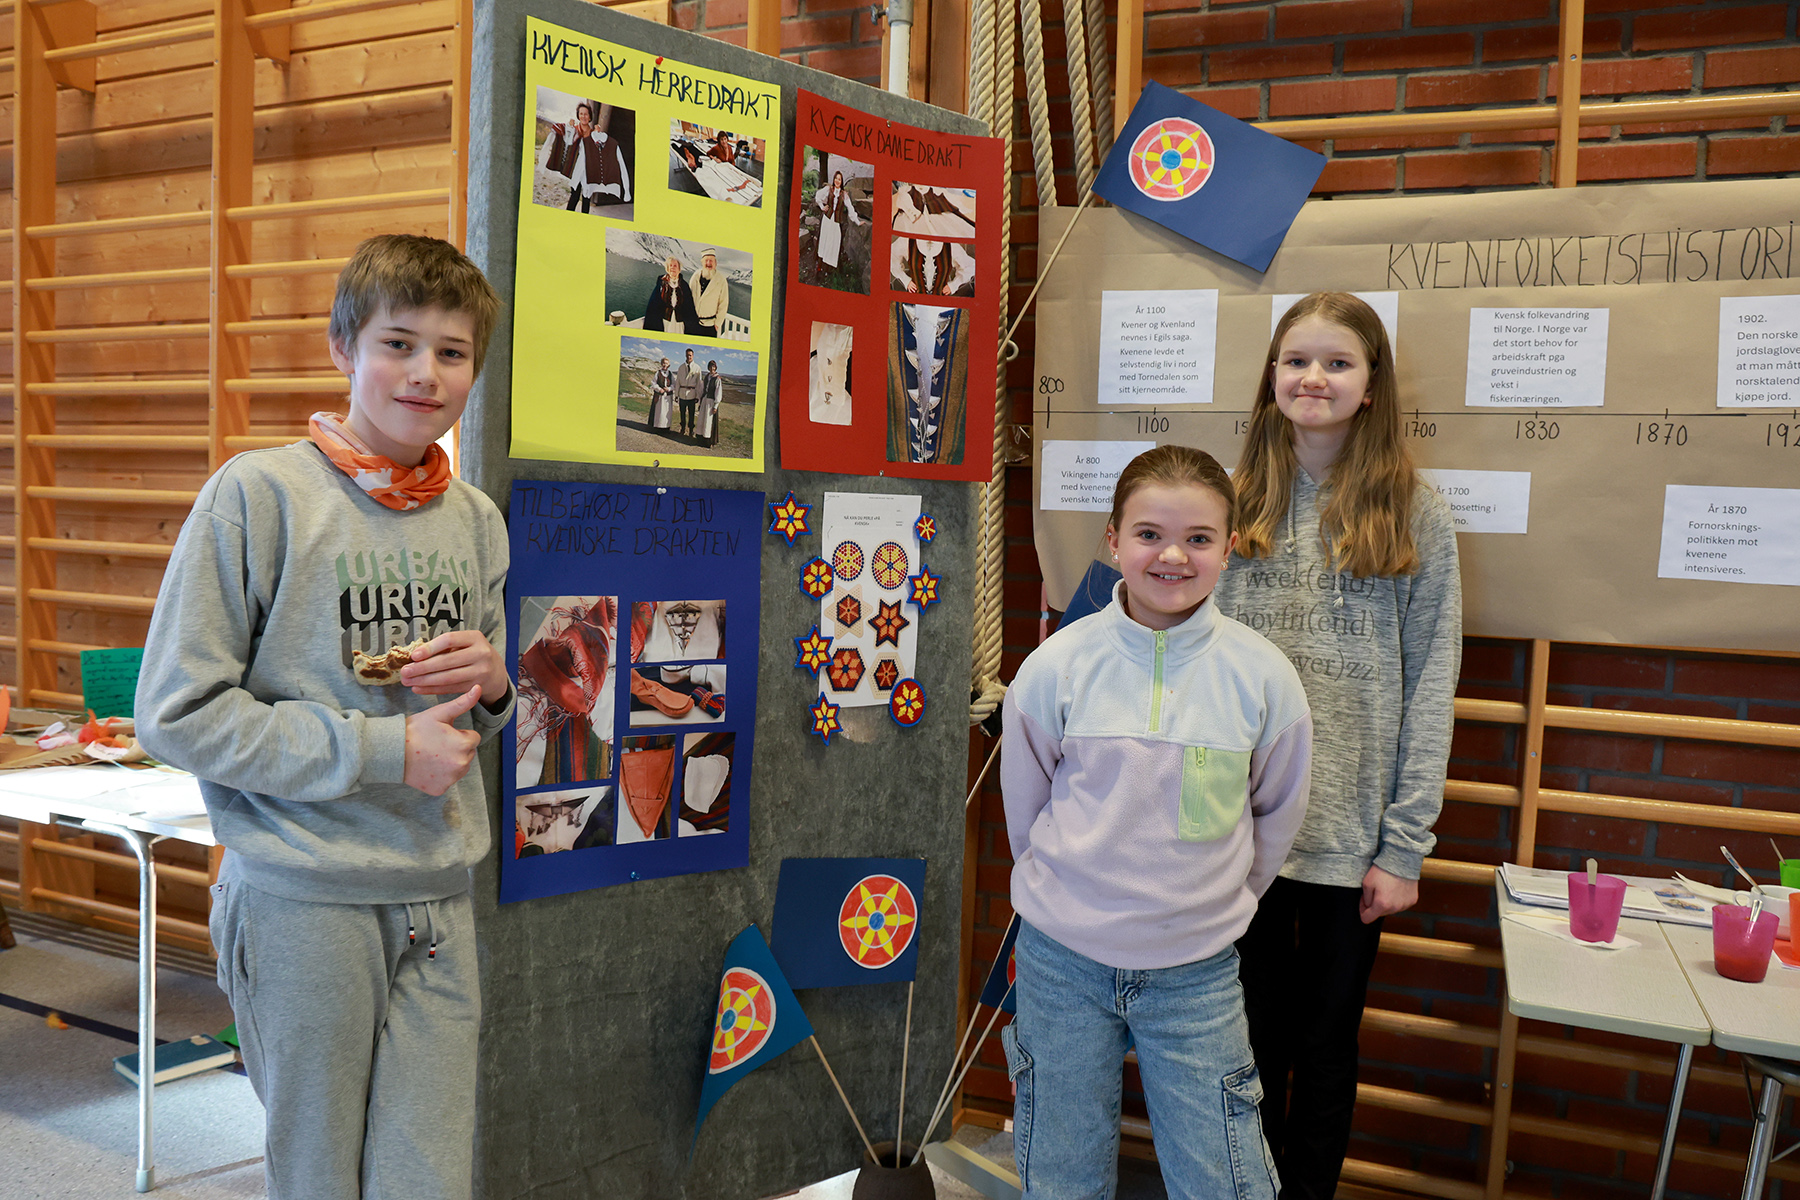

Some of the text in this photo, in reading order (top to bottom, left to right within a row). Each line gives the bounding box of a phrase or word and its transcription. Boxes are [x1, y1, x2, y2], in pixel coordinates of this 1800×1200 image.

[533, 30, 778, 121] KVENSK HERREDRAKT
[810, 105, 873, 151] KVENSK
[1135, 305, 1166, 314] År 1100
[1494, 310, 1590, 320] Kvensk folkevandring
[1738, 314, 1768, 324] 1902.
[1121, 321, 1147, 329] Kvener
[1160, 320, 1196, 328] Kvenland
[1493, 325, 1503, 333] til
[1504, 326, 1535, 335] Norge.
[1542, 325, 1571, 335] Norge
[1737, 330, 1799, 340] Den norske
[1153, 333, 1171, 342] Egils
[1493, 339, 1508, 347] det
[1534, 339, 1562, 347] behov
[1564, 339, 1578, 347] for
[1120, 348, 1152, 356] Kvenene
[1492, 353, 1565, 362] arbeidskraft pga
[1119, 361, 1162, 369] selvstendig
[1163, 360, 1173, 368] liv
[1178, 360, 1197, 368] nord
[1736, 362, 1747, 371] at
[1749, 362, 1774, 370] man
[1491, 367, 1577, 376] gruveindustrien og
[1119, 373, 1136, 381] med
[1138, 373, 1181, 381] Tornedalen
[1038, 375, 1065, 395] 800
[1490, 381, 1514, 389] vekst
[1118, 386, 1188, 395] sitt kjerneområde.
[1490, 394, 1562, 404] fiskerinæringen.
[1735, 392, 1792, 403] kjøpe jord.
[1137, 416, 1170, 434] 1100
[1404, 421, 1437, 439] 1700
[1515, 420, 1561, 441] 1830
[1636, 422, 1689, 447] 1870
[1075, 455, 1085, 464] År
[1061, 471, 1098, 480] Vikingene
[1061, 483, 1078, 491] med
[1080, 483, 1112, 491] kvenene
[1436, 485, 1470, 496] År 1700
[1060, 496, 1090, 504] svenske
[516, 487, 631, 522] TILBEHØR
[672, 496, 714, 524] DEN
[1707, 503, 1747, 515] År 1870
[1688, 521, 1762, 534] Fornorsknings-
[526, 522, 741, 557] KVENSKE DRAKTEN
[1687, 536, 1758, 546] politikken mot
[1686, 549, 1728, 559] kvenene
[1684, 563, 1746, 575] intensiveres.
